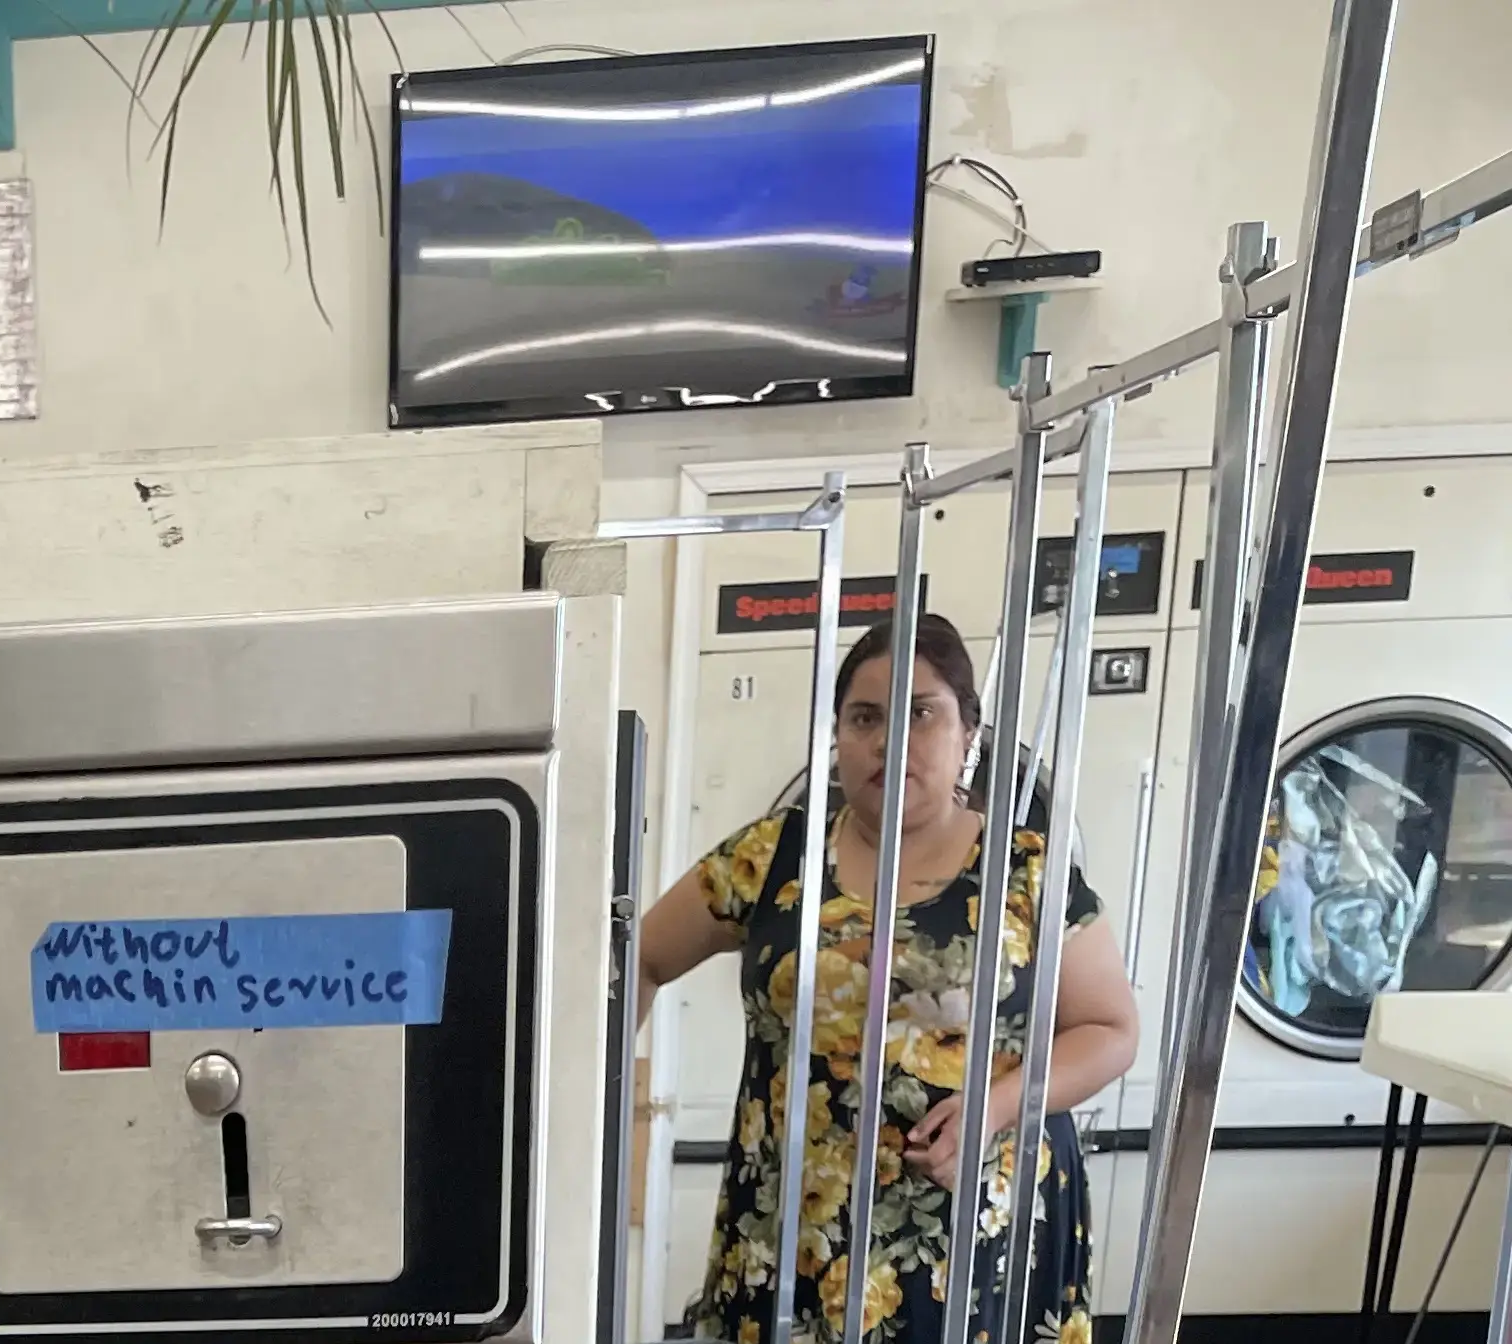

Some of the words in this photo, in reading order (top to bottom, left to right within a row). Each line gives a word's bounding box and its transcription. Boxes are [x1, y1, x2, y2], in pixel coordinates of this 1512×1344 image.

[732, 676, 755, 700] 81
[45, 965, 218, 1008] machin
[237, 959, 408, 1013] service
[371, 1311, 451, 1328] 200017941
